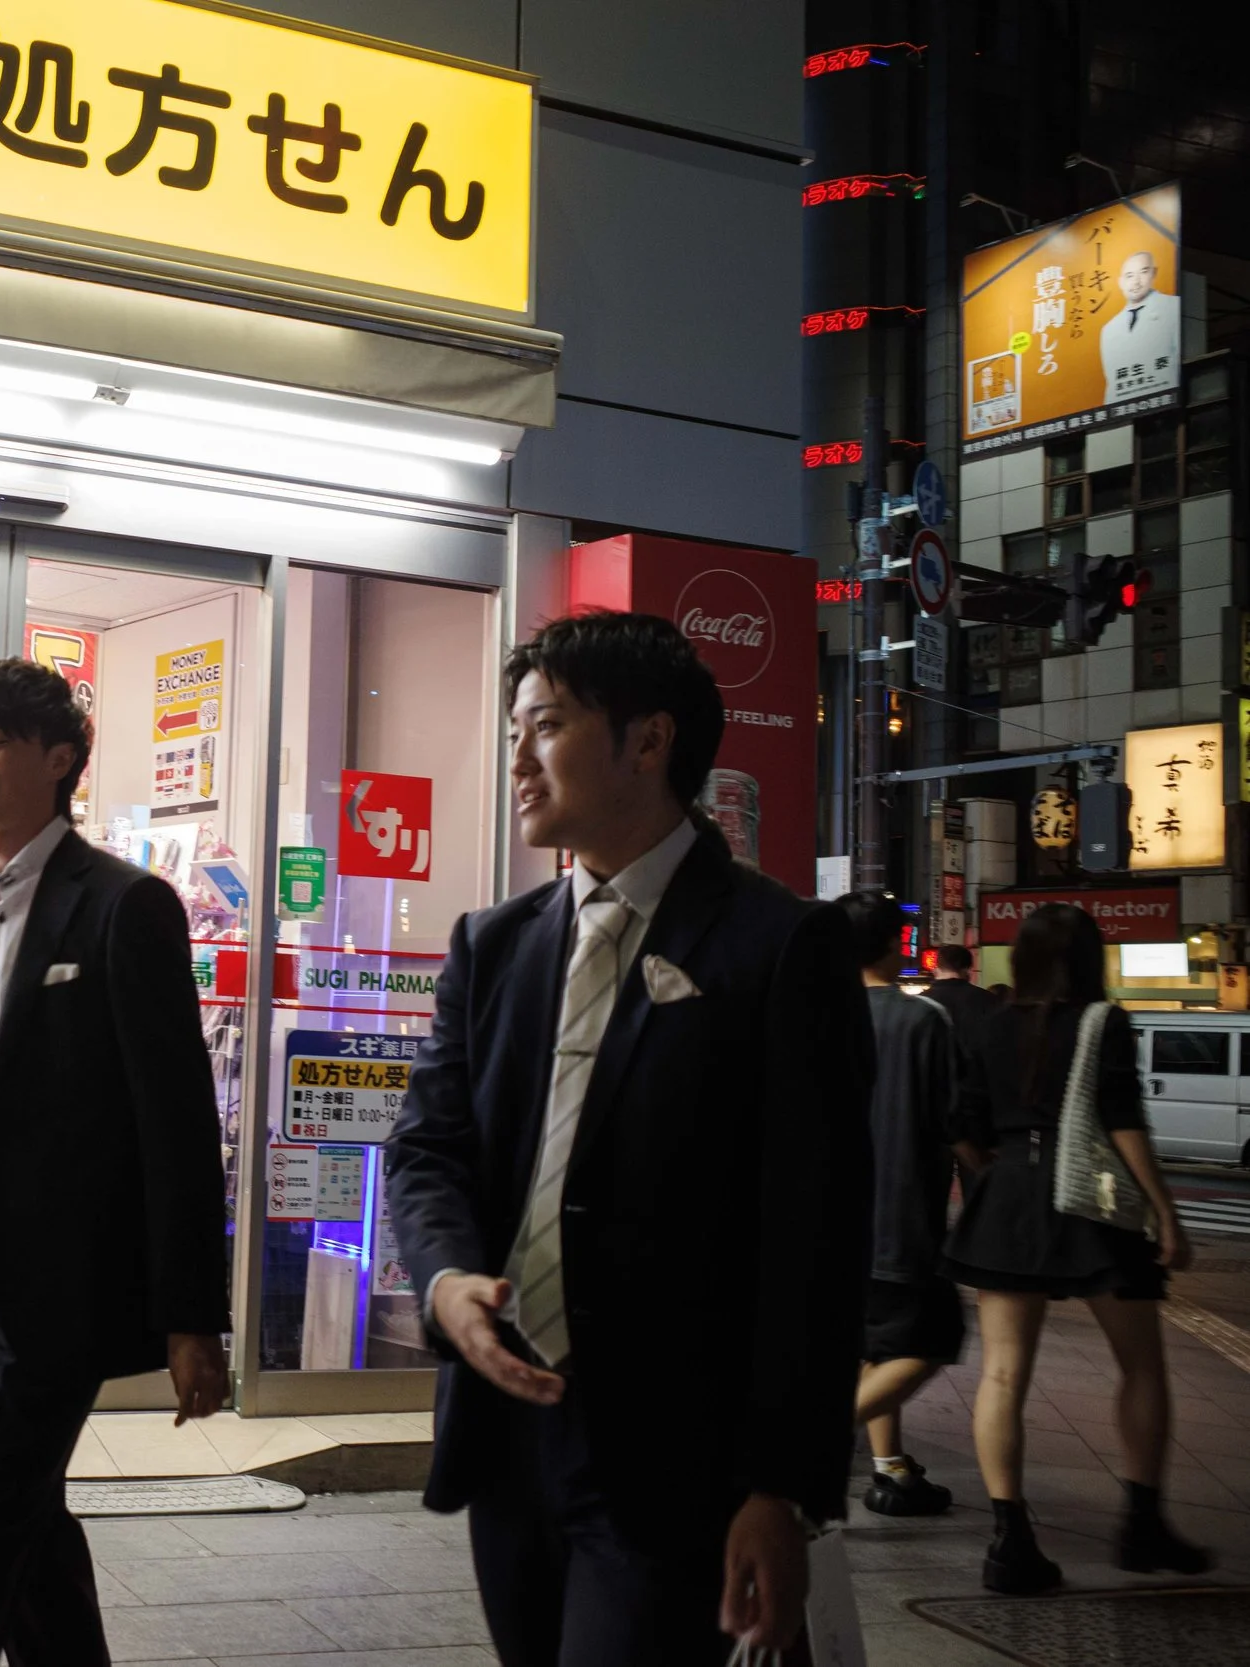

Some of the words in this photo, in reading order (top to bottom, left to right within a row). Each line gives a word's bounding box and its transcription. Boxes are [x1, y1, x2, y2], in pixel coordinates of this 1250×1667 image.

[803, 49, 870, 78] ラオケ
[803, 178, 870, 207] ラオケ
[1085, 218, 1114, 314] バーキン
[801, 309, 868, 337] ラオケ
[1032, 266, 1067, 375] 豊胸しろ
[171, 650, 206, 669] MONEY
[157, 664, 221, 693] EXCHANGE
[733, 710, 793, 728] FEELING
[346, 780, 429, 873] くすり
[1092, 900, 1170, 919] factory
[305, 969, 348, 989] SUGI
[358, 971, 438, 994] PHARMA
[339, 1036, 418, 1058] スギ薬局
[298, 1060, 409, 1089] 処方せん受
[303, 1107, 354, 1122] 土・日曜日
[303, 1123, 328, 1138] 祝日
